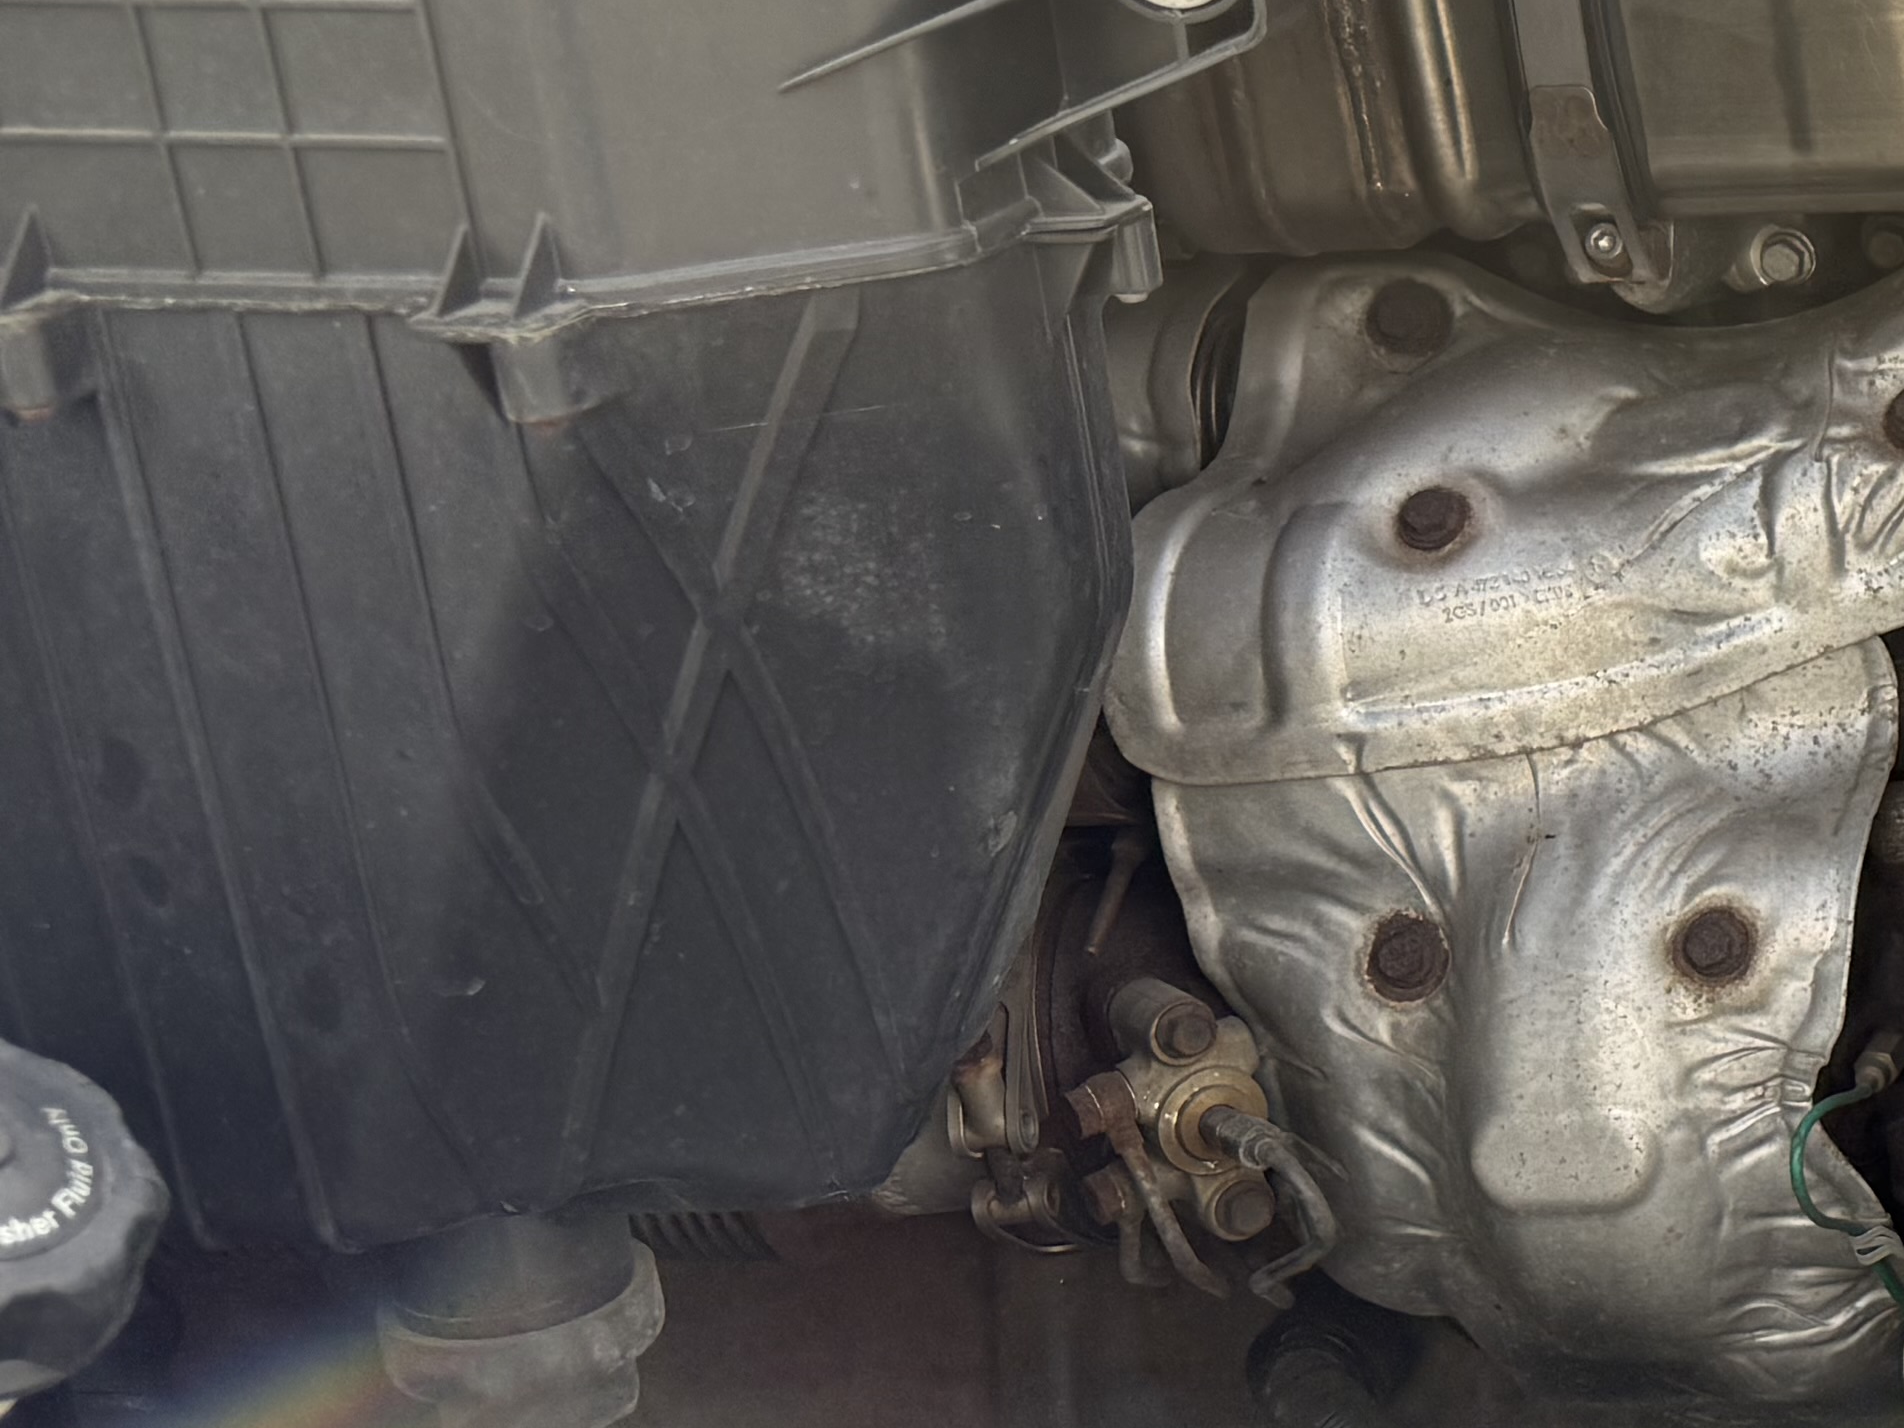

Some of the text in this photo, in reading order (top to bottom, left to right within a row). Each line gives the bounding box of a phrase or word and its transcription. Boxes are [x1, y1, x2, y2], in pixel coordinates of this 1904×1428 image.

[0, 1107, 94, 1245] sher Fluid Only
